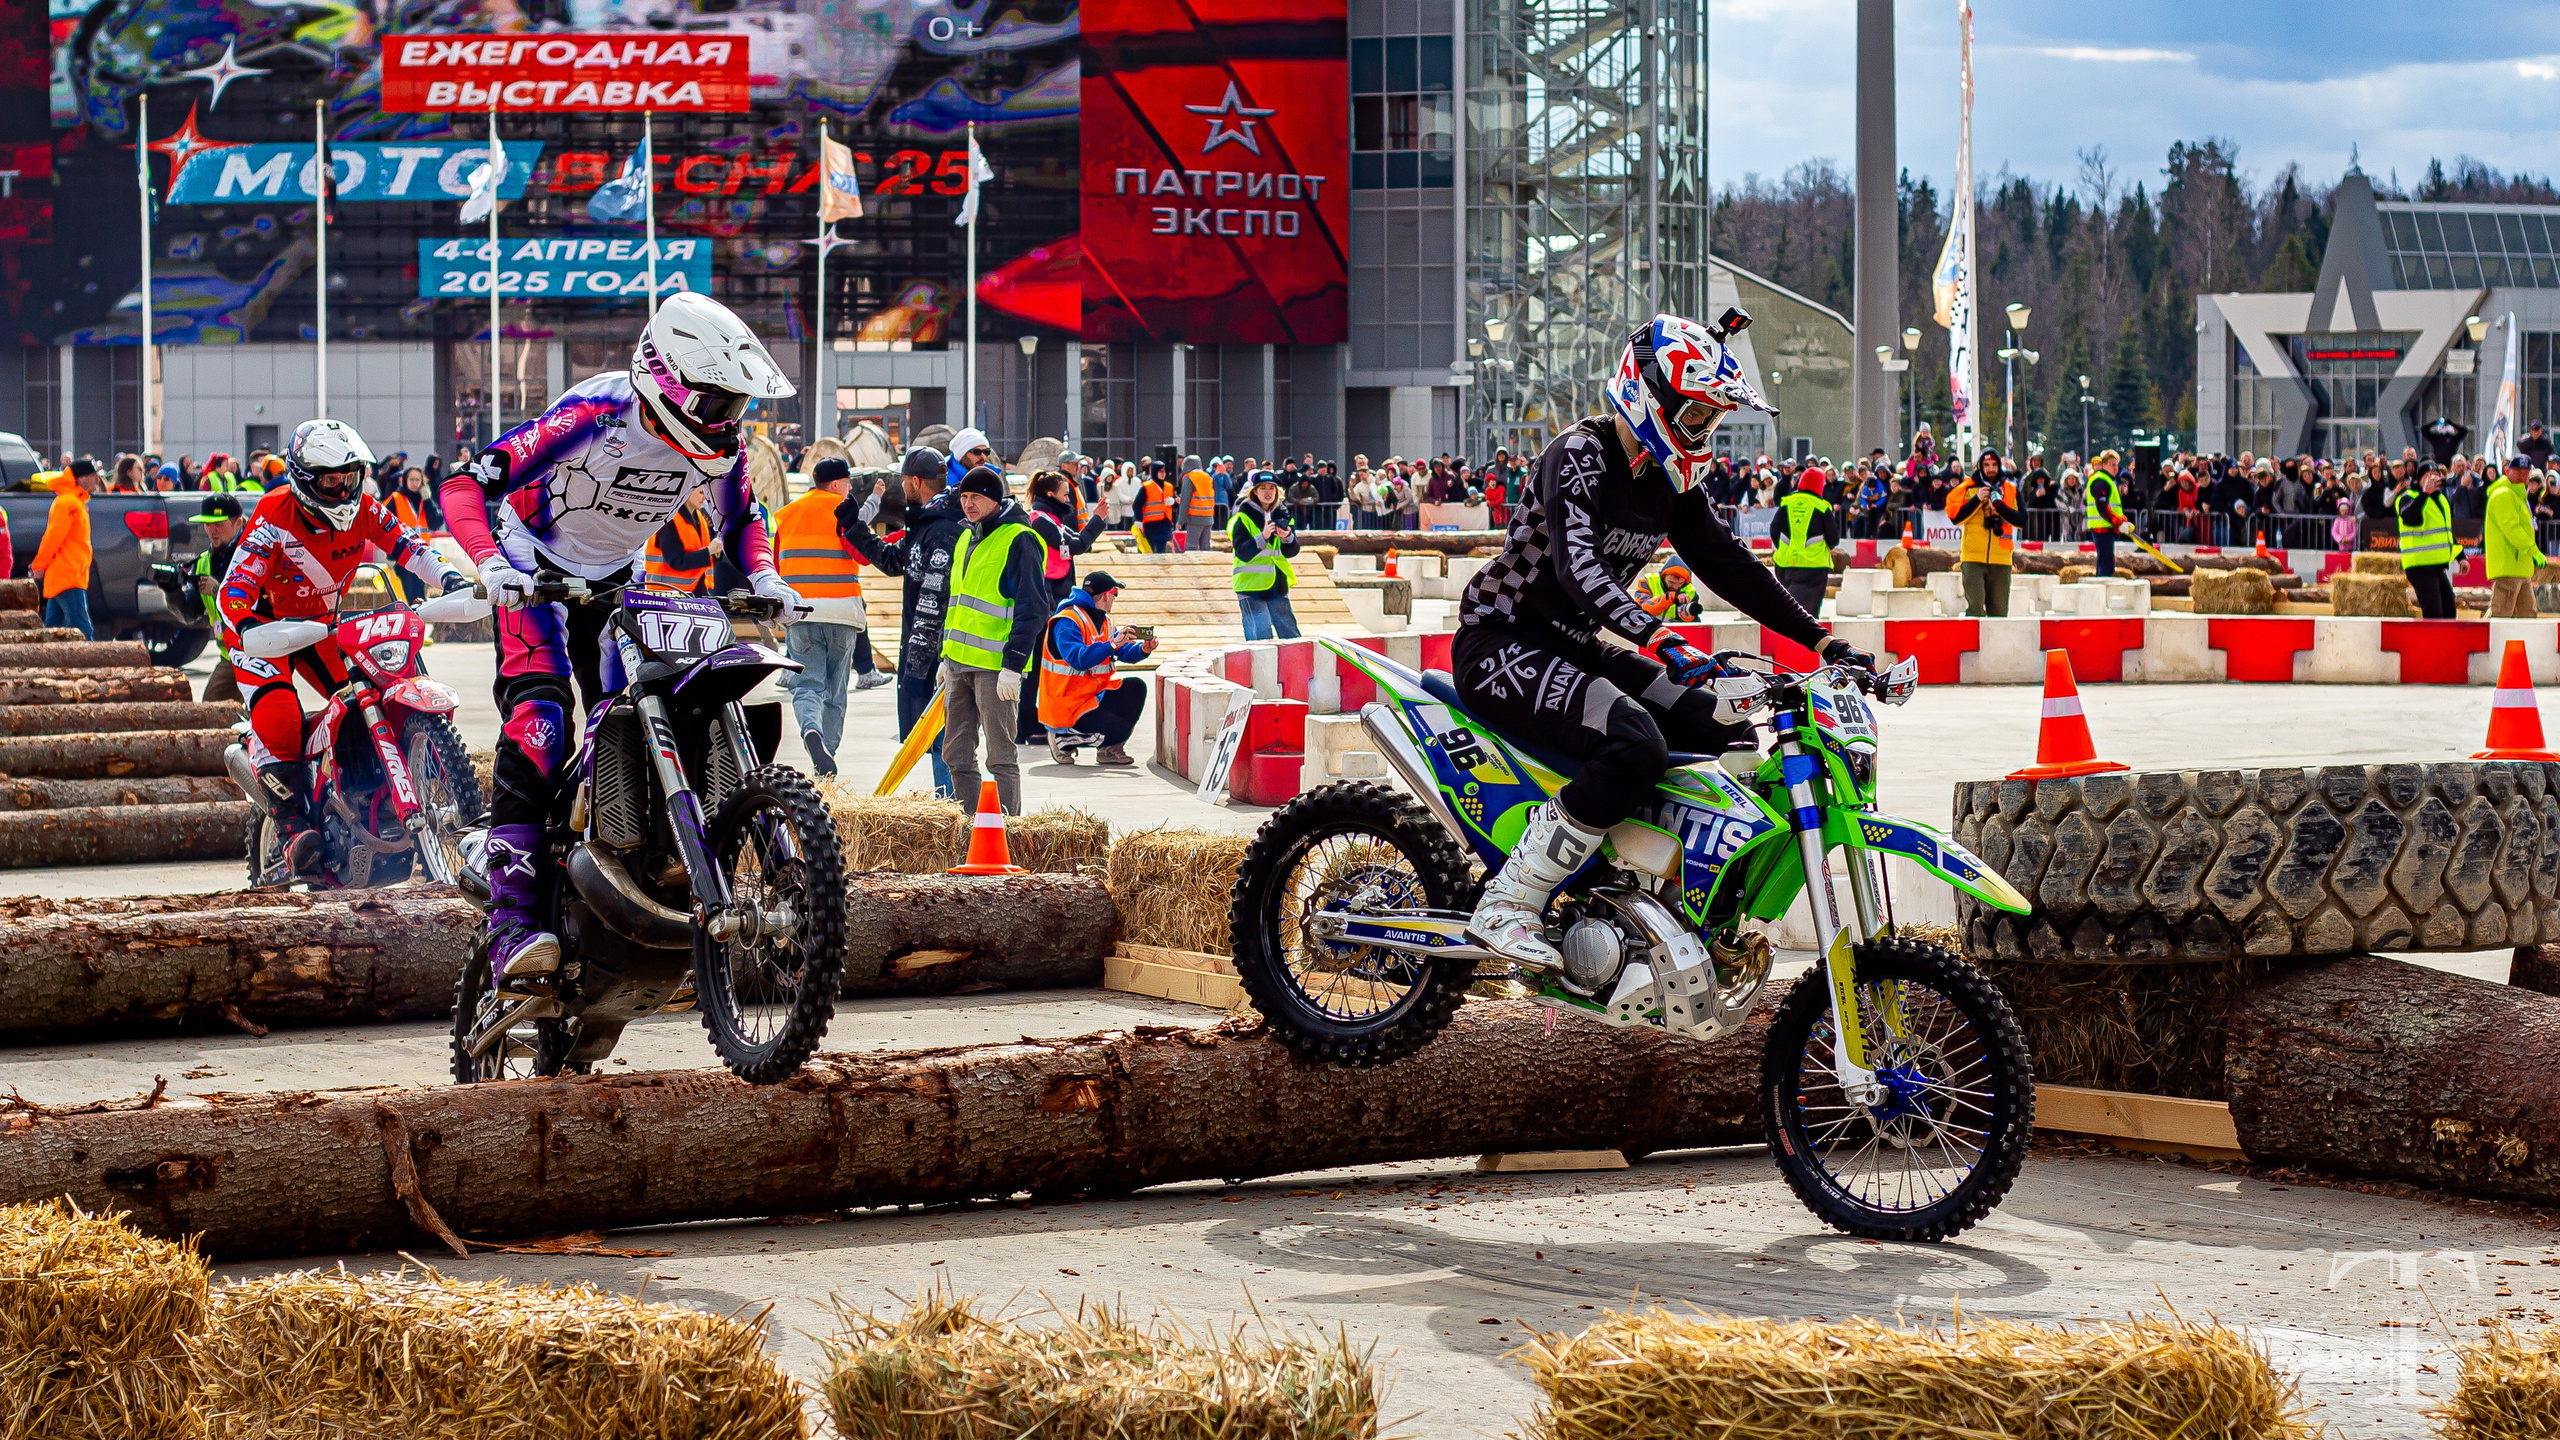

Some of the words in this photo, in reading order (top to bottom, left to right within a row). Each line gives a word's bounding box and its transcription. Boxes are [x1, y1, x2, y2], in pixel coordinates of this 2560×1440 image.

[399, 41, 732, 69] ЕЖЕГОДНАЯ
[426, 81, 705, 106] ВЫСТАВКА
[1115, 167, 1326, 201] ПАТРИОТ
[1151, 207, 1300, 238] ЭКСПО
[433, 240, 501, 261] 4-6
[511, 240, 695, 261] АПРЕЛЯ
[439, 271, 550, 293] 2025
[562, 271, 691, 294] ГОДА
[616, 471, 683, 492] KTM
[610, 490, 646, 502] FACTORY
[646, 496, 674, 504] RACING
[1564, 498, 1654, 635] AVANTIS
[674, 600, 706, 611] TIREX
[355, 613, 406, 645] 747
[636, 609, 728, 655] 177
[675, 656, 702, 665] KT
[1833, 694, 1864, 724] 96
[1436, 726, 1488, 772] 96
[1490, 753, 1510, 777] ENDURO
[1720, 784, 1748, 809] EXCEL
[667, 810, 681, 842] FACTORY
[1384, 929, 1427, 943] AVANTIS
[1778, 1127, 1796, 1156] KENDA
[1820, 1180, 1841, 1199] EXCEL
